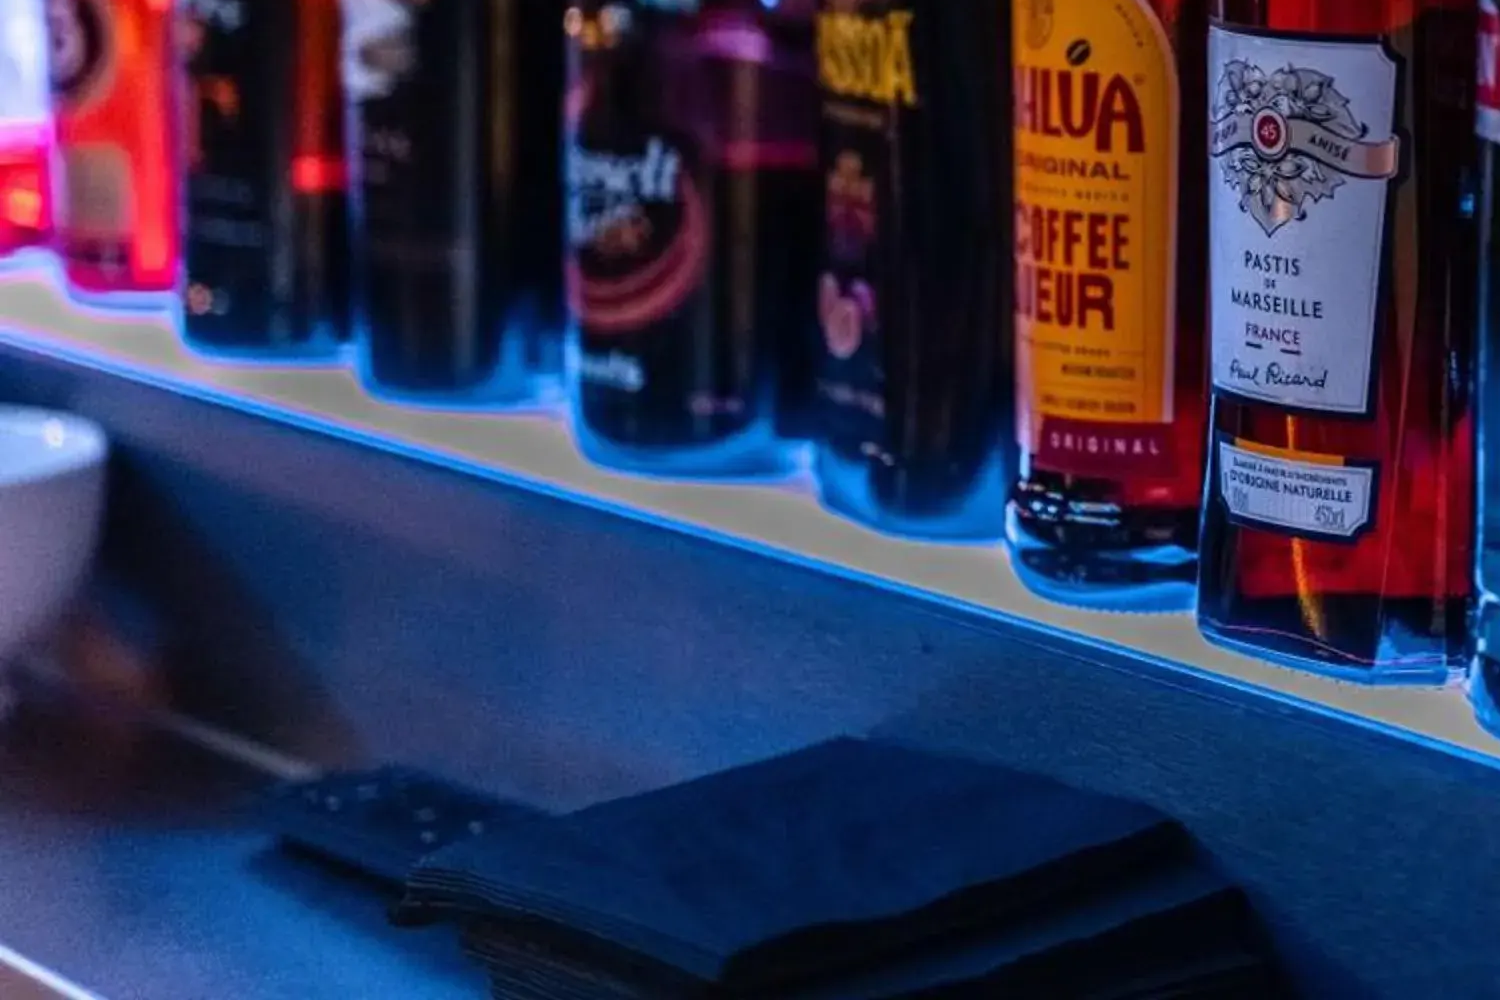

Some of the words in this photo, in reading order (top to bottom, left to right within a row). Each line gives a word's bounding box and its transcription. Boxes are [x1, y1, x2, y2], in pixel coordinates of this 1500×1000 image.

[1244, 250, 1300, 277] PASTIS
[1231, 287, 1324, 319] MARSEILLE
[1245, 322, 1301, 346] FRANCE
[1265, 361, 1329, 389] Ricard
[1051, 432, 1160, 455] ORIGINAL
[1283, 482, 1353, 503] NATURELLE
